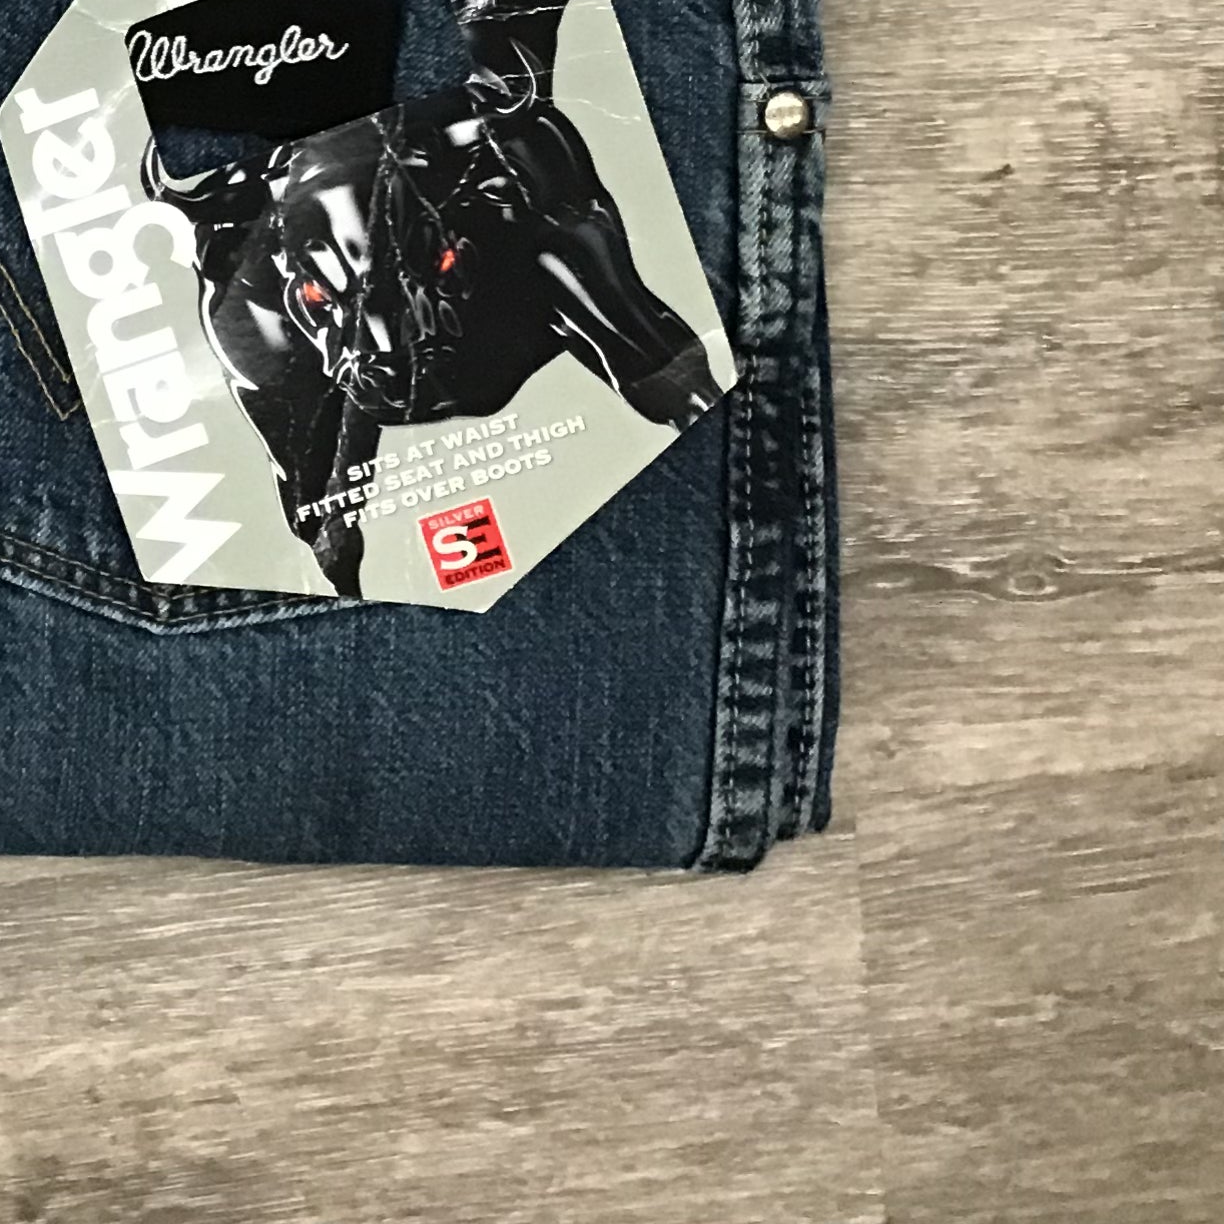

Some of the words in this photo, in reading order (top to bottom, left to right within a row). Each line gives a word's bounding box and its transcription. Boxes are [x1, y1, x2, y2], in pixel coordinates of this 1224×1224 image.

[128, 25, 350, 85] Wrangler
[14, 87, 243, 583] Wrangler
[296, 481, 380, 523] FITTED
[384, 461, 445, 492] SEAT
[453, 442, 505, 471] AND
[509, 415, 587, 451] THIGH
[346, 452, 401, 483] SITS
[407, 440, 436, 463] AT
[440, 413, 520, 451] WAIST
[342, 498, 397, 529] FITS
[401, 476, 466, 508] OVER
[470, 448, 553, 486] BOOTS
[427, 504, 485, 530] SILVER
[445, 558, 506, 586] EDITION
